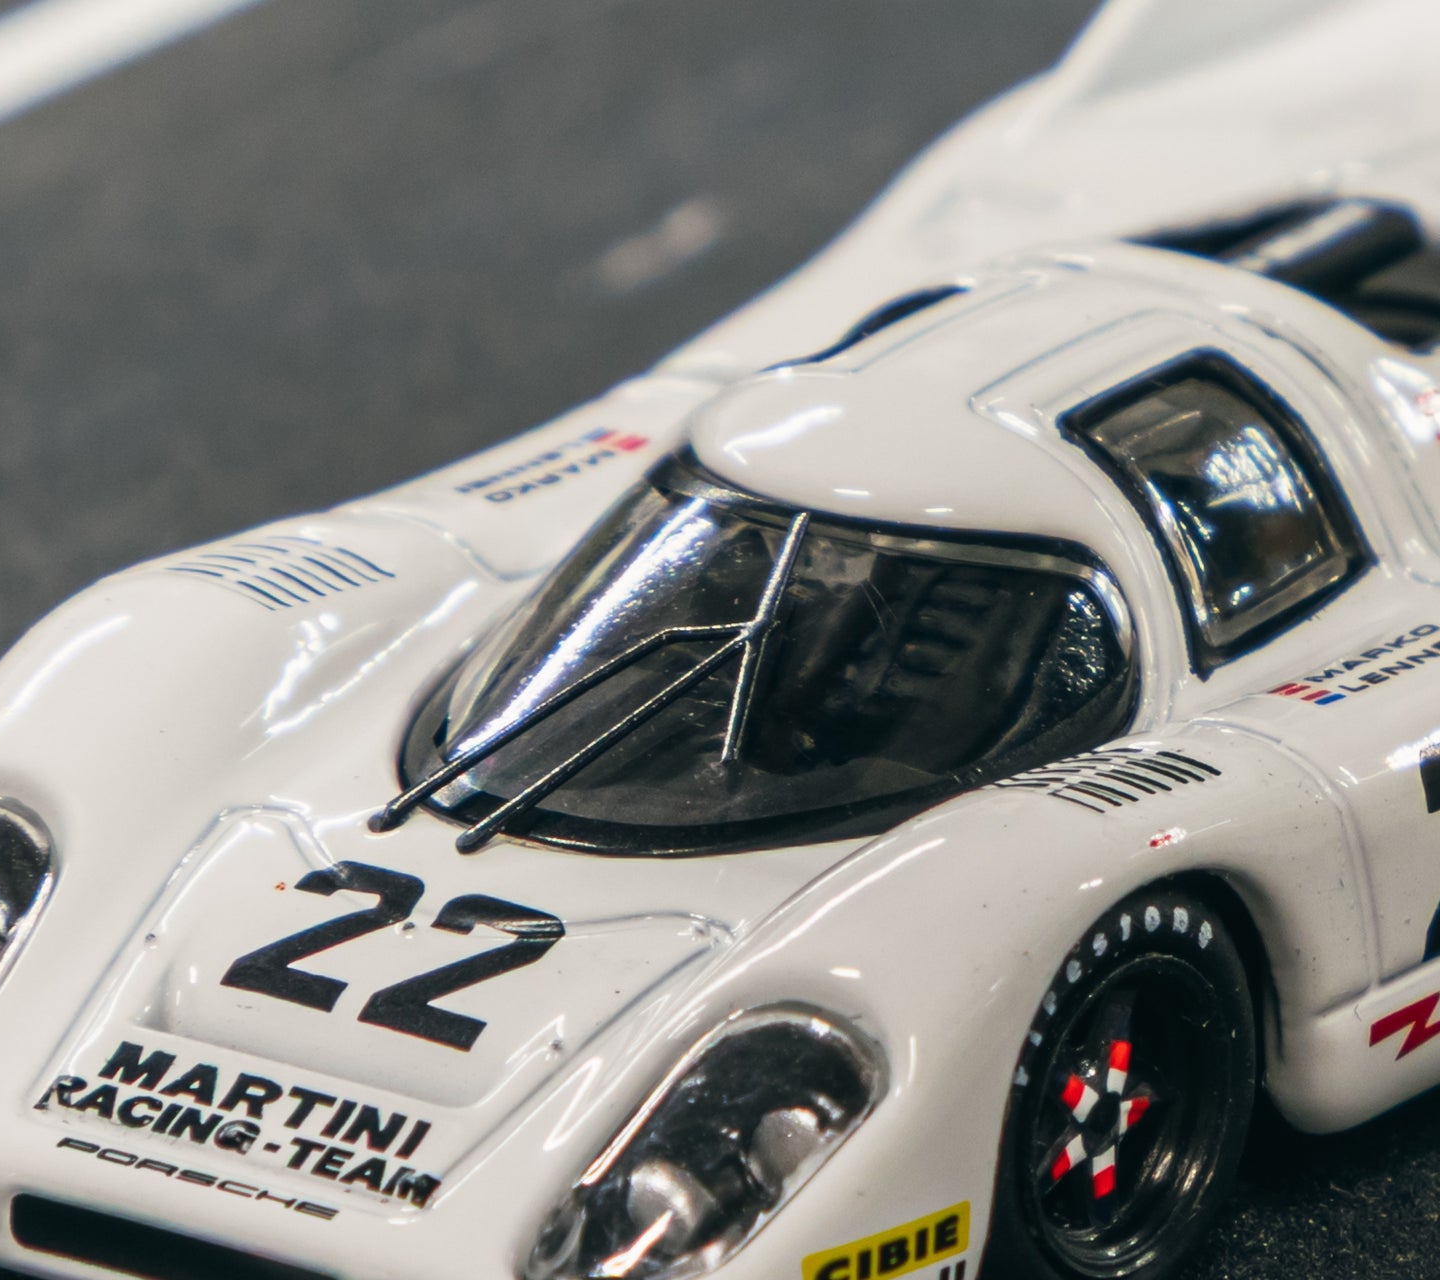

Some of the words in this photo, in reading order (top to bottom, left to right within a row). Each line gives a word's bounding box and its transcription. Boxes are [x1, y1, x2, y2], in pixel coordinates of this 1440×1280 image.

[1303, 623, 1440, 683] MARKO
[219, 860, 567, 1053] 22
[98, 1041, 432, 1158] MARTINI
[56, 1137, 340, 1220] PORSCHE
